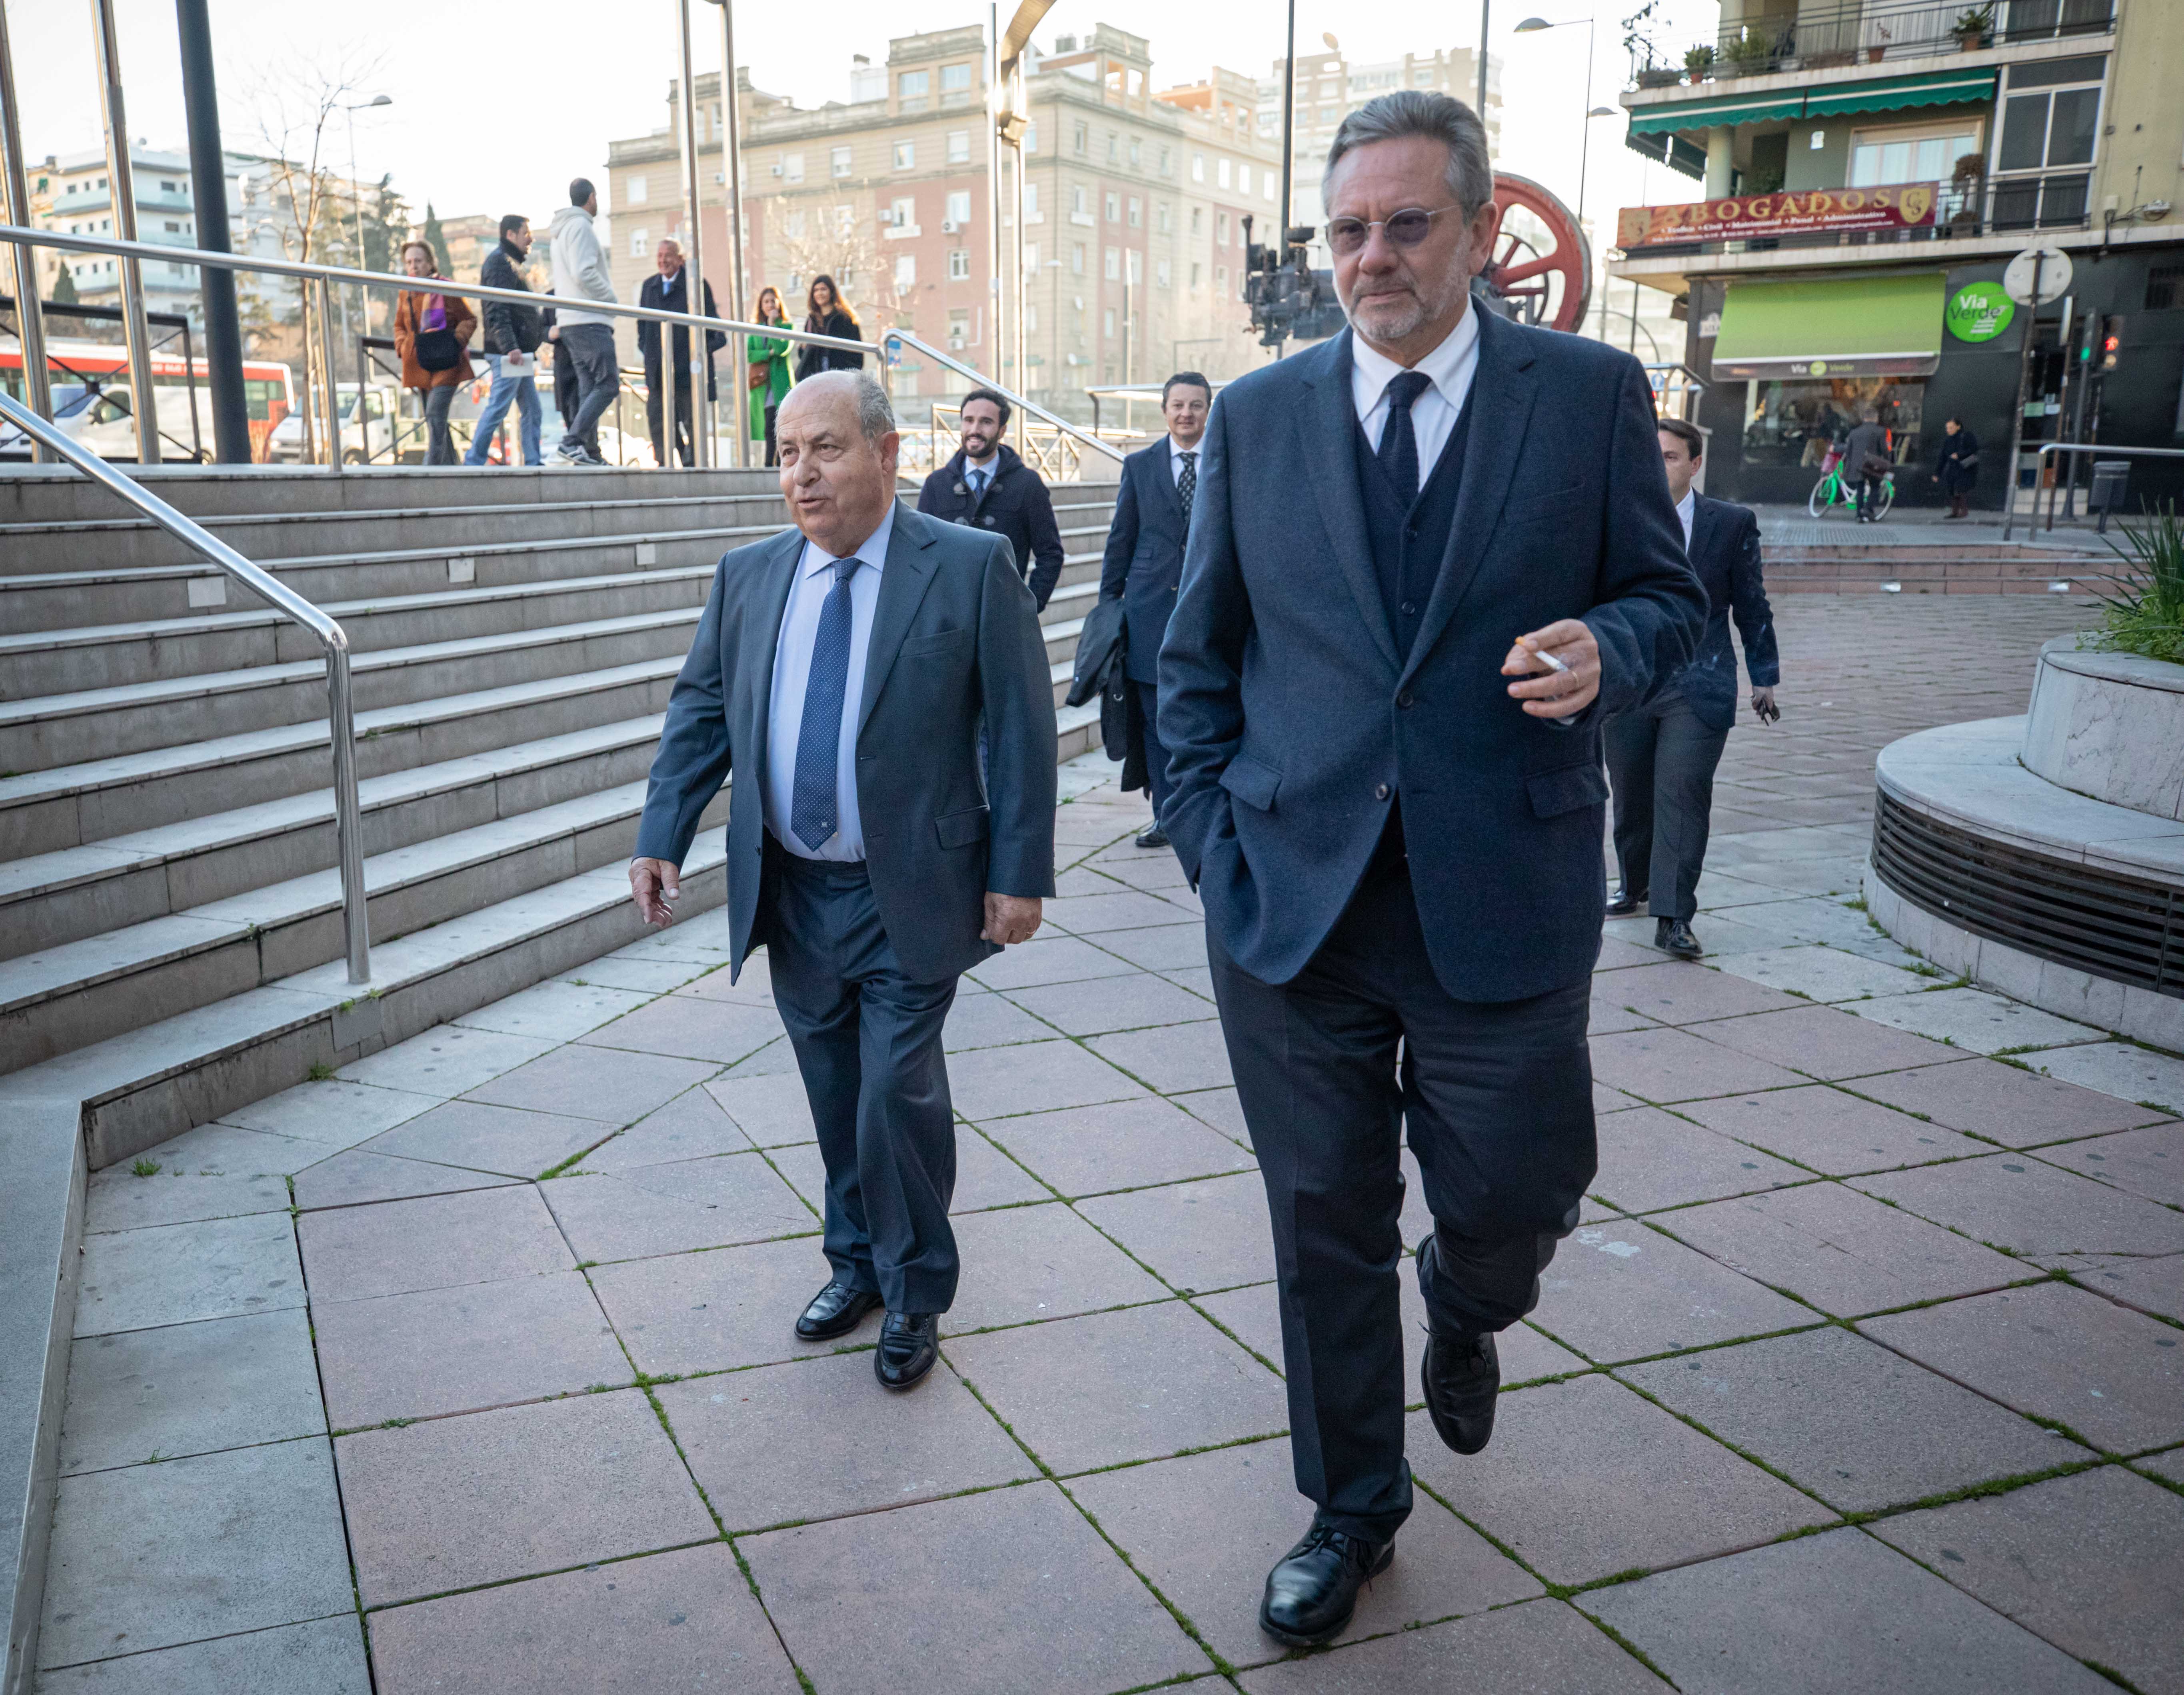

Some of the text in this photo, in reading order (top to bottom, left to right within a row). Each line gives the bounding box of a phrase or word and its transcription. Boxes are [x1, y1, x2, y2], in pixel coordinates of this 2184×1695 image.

[1663, 188, 1891, 225] ABOGADOS
[1790, 215, 1814, 224] Penal
[1960, 294, 1987, 309] Via
[1950, 304, 2000, 320] Verde
